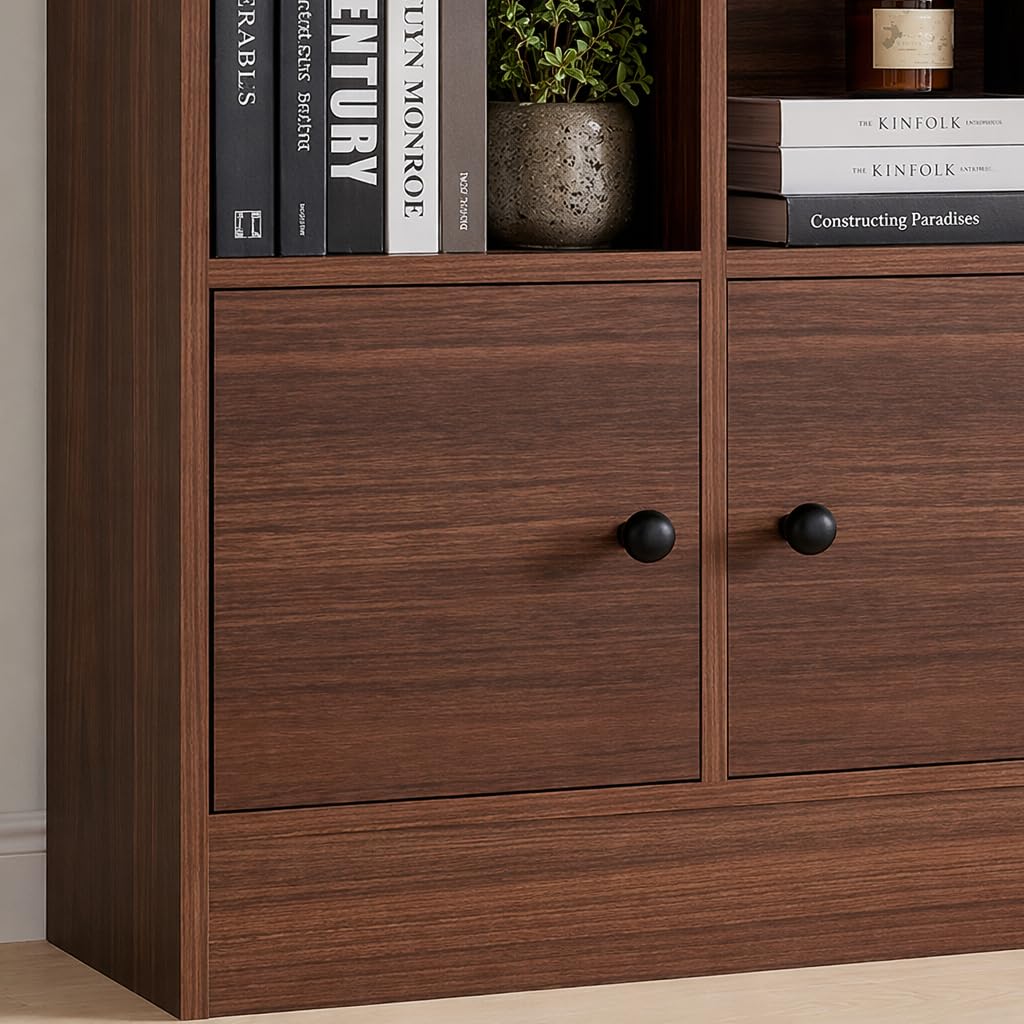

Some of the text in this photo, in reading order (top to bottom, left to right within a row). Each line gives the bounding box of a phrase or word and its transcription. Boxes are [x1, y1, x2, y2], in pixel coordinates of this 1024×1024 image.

[878, 116, 961, 130] KINFOLK
[403, 80, 425, 219] MONROE
[872, 163, 956, 177] KINFOLK
[810, 211, 981, 231] Constructing Paradises
